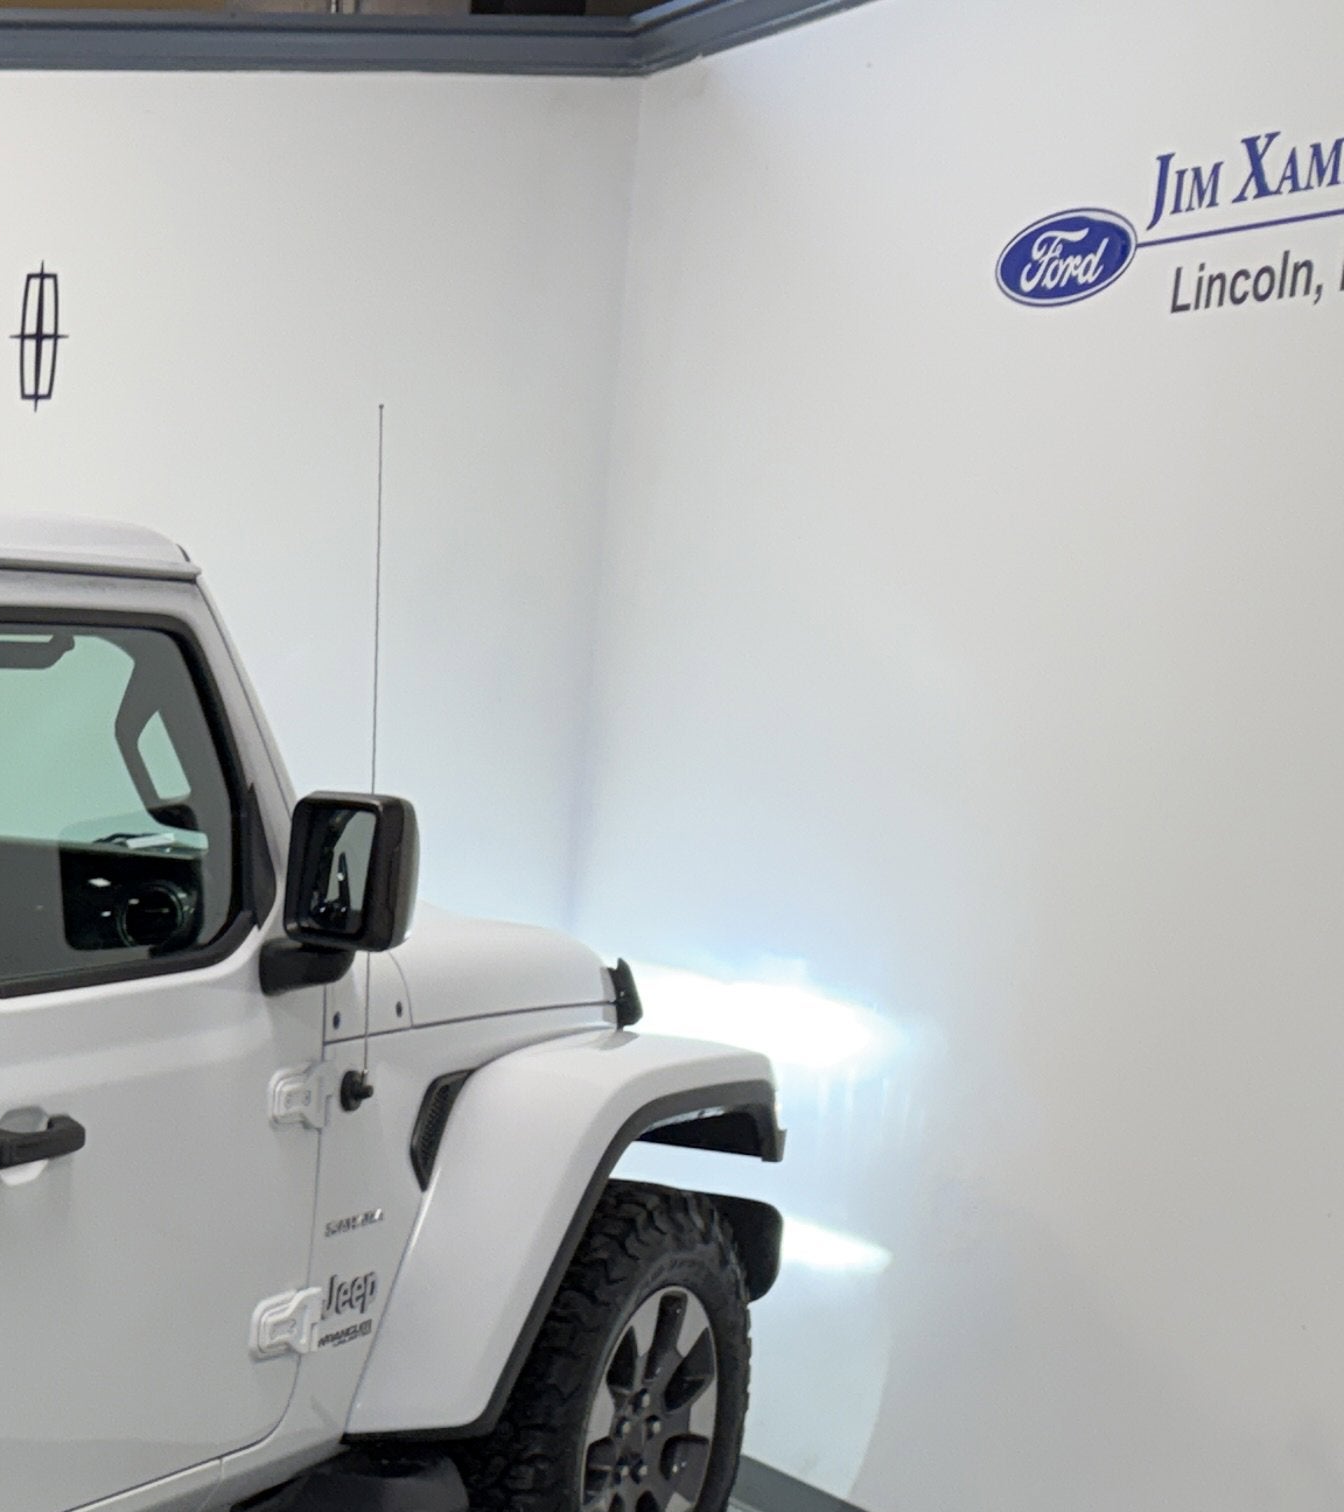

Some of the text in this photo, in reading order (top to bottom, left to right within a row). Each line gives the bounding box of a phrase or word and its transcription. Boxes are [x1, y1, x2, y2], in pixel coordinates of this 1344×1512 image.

[1146, 131, 1344, 231] JIM XAM
[1018, 227, 1110, 293] Ford
[1170, 250, 1323, 314] Lincoln,
[320, 1271, 377, 1320] Jeep
